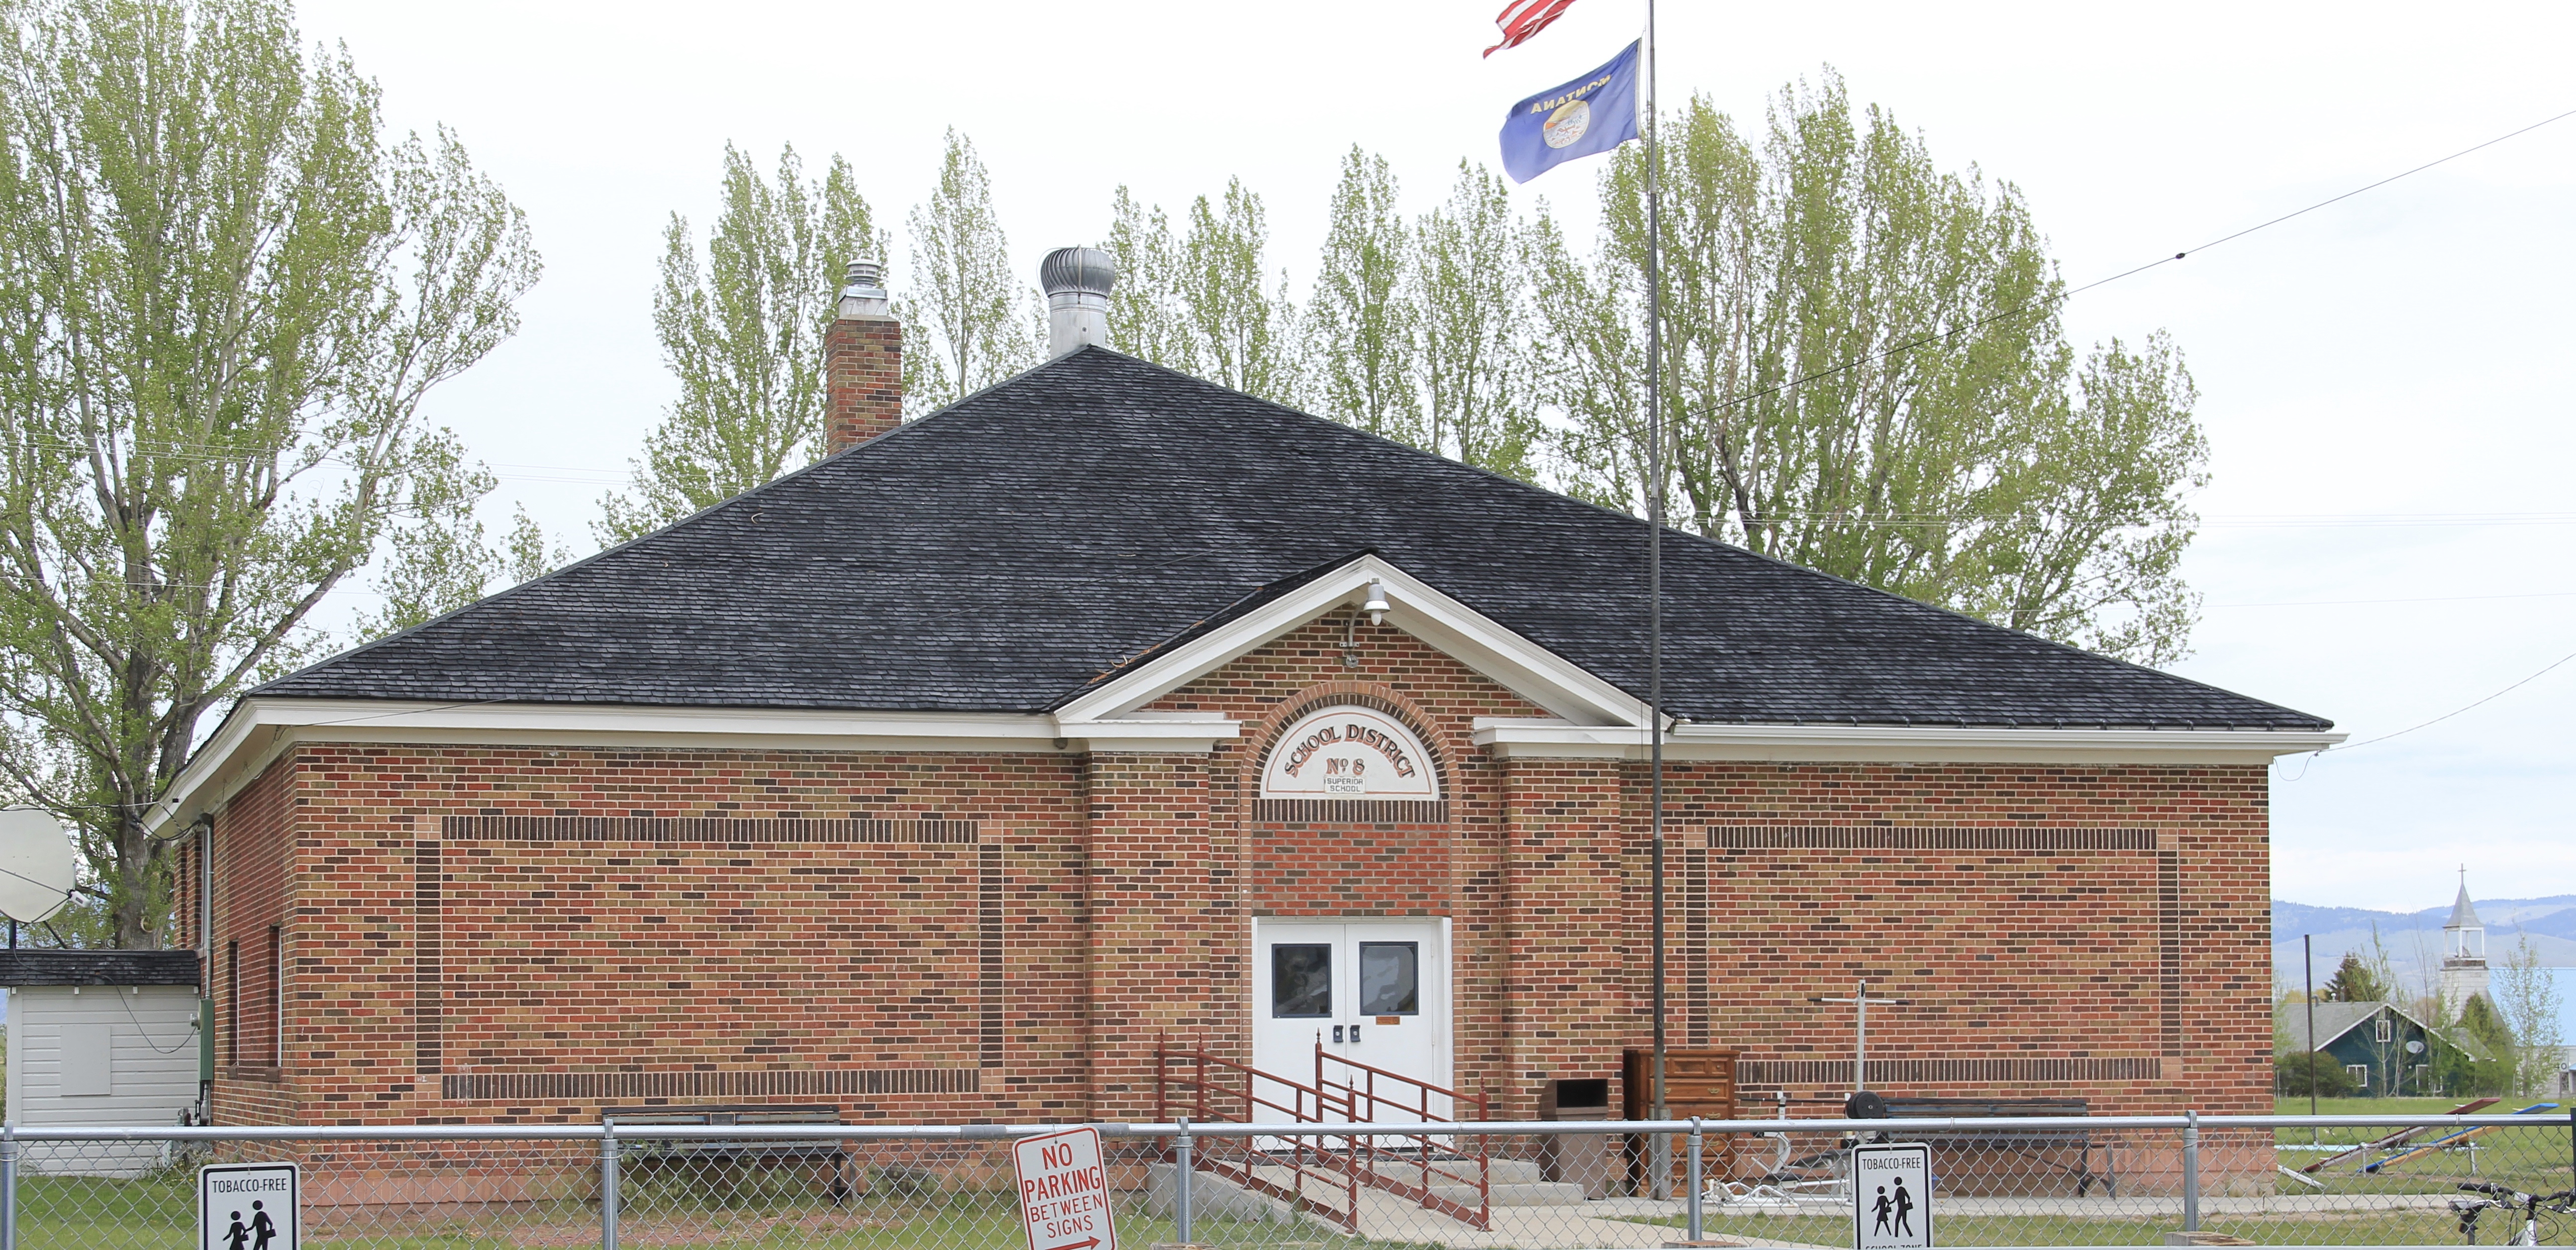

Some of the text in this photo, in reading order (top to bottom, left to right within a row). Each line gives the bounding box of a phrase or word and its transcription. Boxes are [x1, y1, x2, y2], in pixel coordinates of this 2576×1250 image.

[1284, 724, 1415, 778] SCHOOL DISTRICT
[1353, 758, 1365, 775] 8
[1042, 1143, 1073, 1170] NO
[1862, 1157, 1921, 1170] TOBACCO-FREE
[212, 1178, 287, 1193] TOBACCO-FREE
[1024, 1166, 1101, 1203] PARKING
[1030, 1193, 1103, 1223] BETWEEN
[1046, 1215, 1093, 1239] SIGNS
